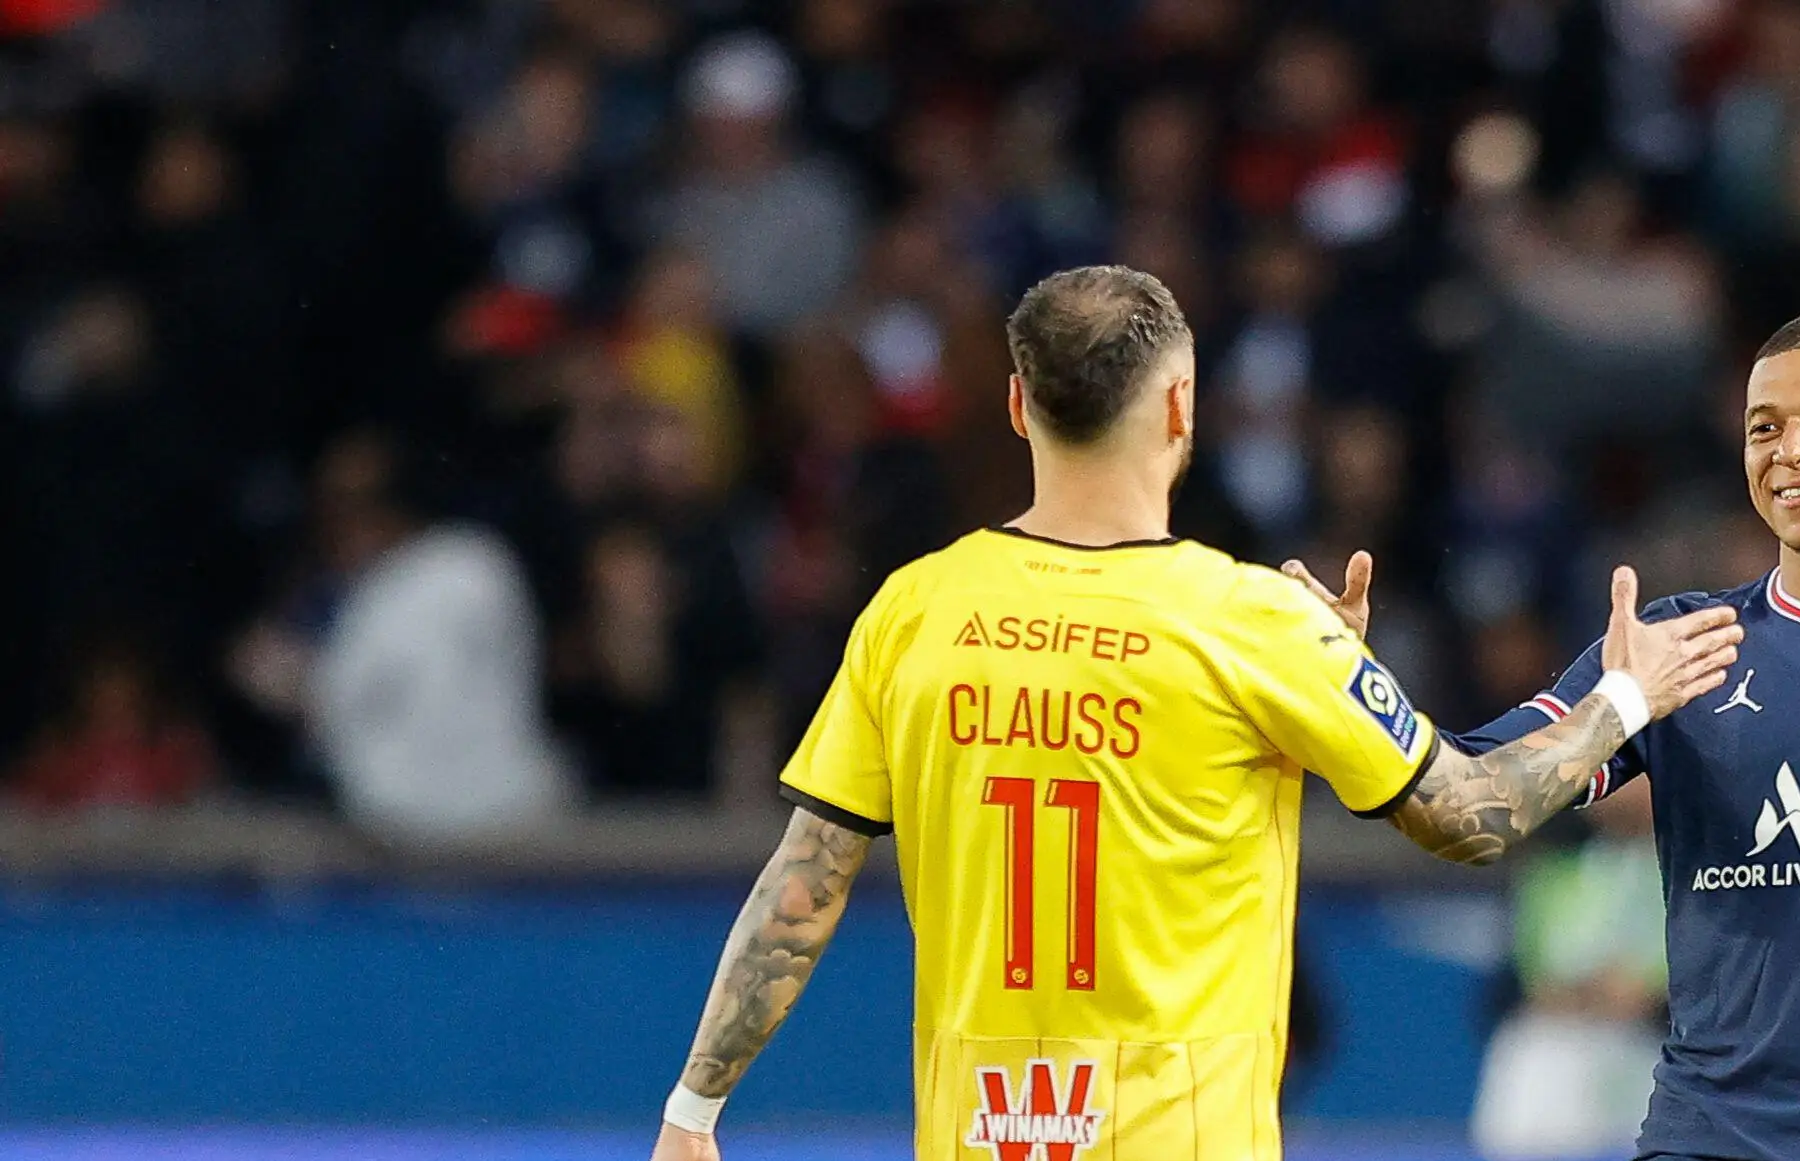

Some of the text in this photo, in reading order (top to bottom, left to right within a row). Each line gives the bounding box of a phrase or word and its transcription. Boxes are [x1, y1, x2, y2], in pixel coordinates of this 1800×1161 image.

[948, 683, 1142, 760] CLAUSS
[981, 776, 1100, 991] 11
[1692, 864, 1767, 892] ACCOR
[984, 1113, 1087, 1144] WINAMAX
